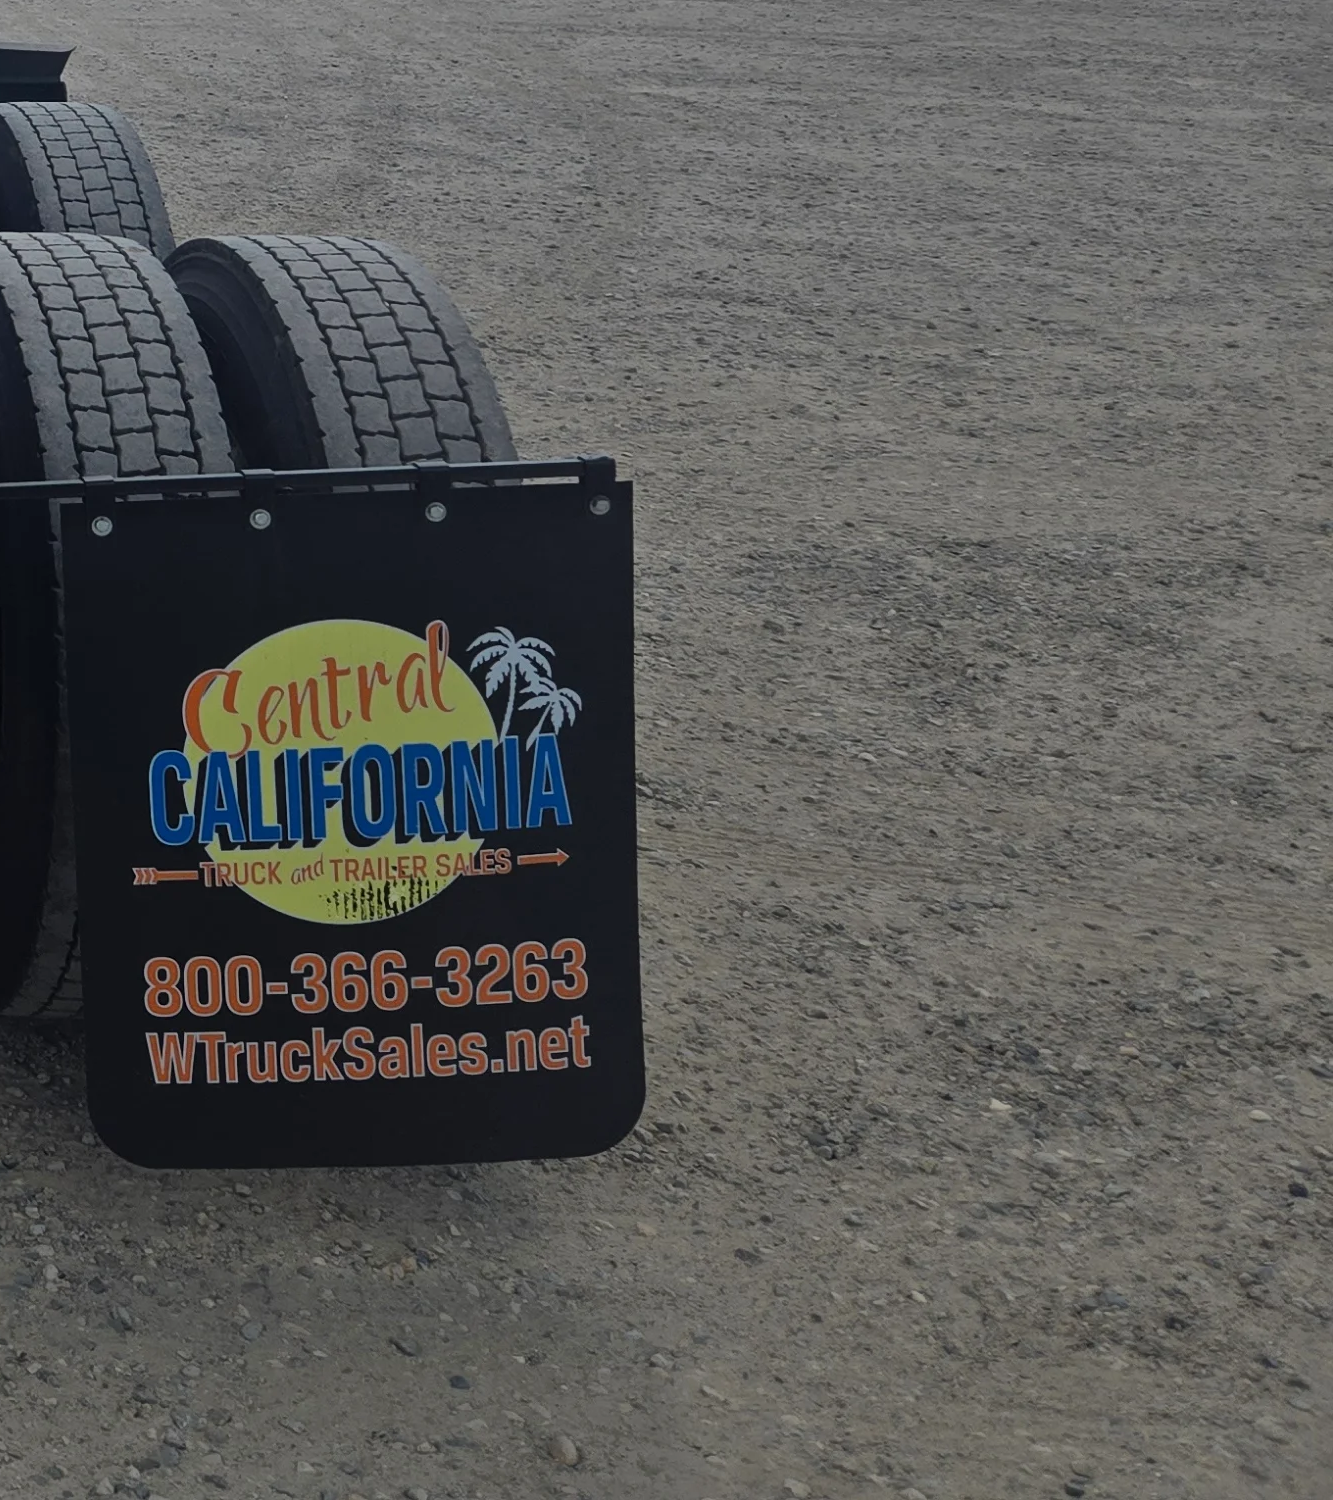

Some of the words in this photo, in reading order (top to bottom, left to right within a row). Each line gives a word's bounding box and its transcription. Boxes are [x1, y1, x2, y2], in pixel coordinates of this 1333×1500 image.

[183, 619, 457, 760] Central
[148, 733, 573, 846] CALIFORNIA
[199, 860, 282, 888] TRUCK
[290, 853, 325, 886] and
[329, 855, 428, 883] TRAILER
[435, 848, 513, 878] SALES
[143, 937, 589, 1018] 800-366-3263
[144, 1014, 592, 1085] WTruckSales.net
